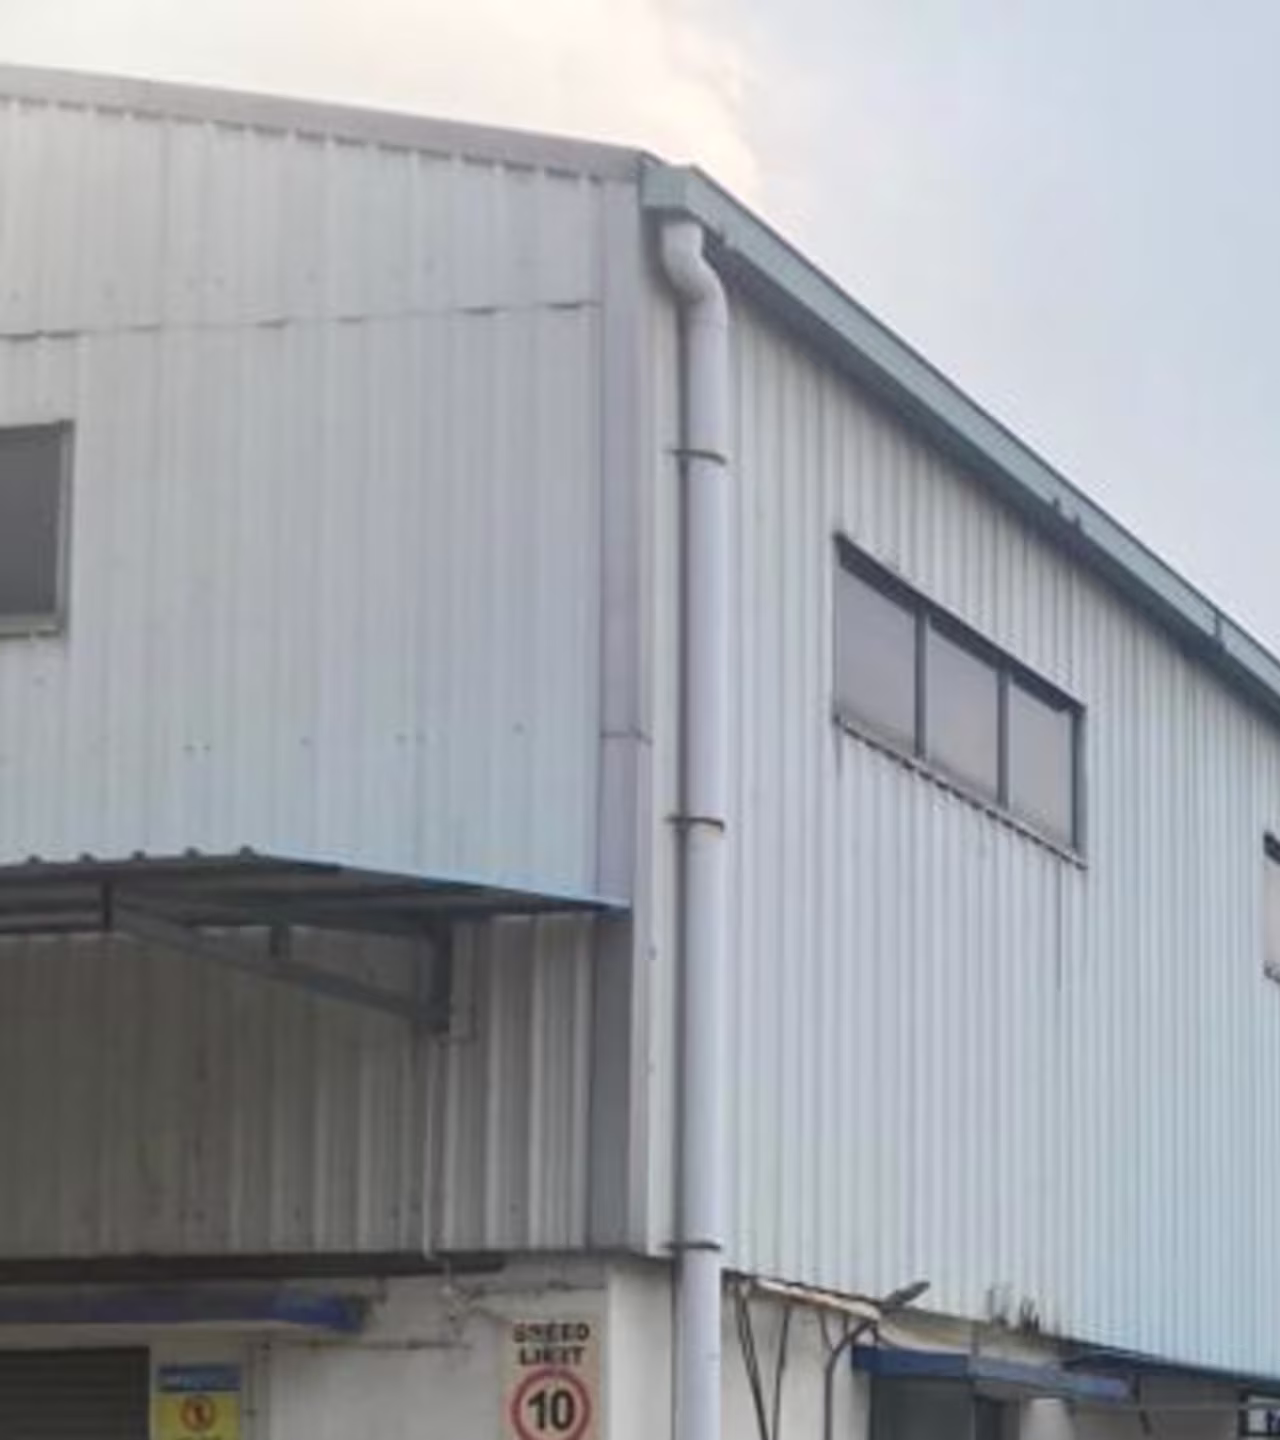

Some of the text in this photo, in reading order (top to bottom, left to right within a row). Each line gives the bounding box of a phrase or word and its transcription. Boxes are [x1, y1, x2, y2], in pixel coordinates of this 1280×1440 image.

[512, 1322, 590, 1343] SPEED
[519, 1346, 585, 1366] LIMIT
[527, 1389, 576, 1431] 10
